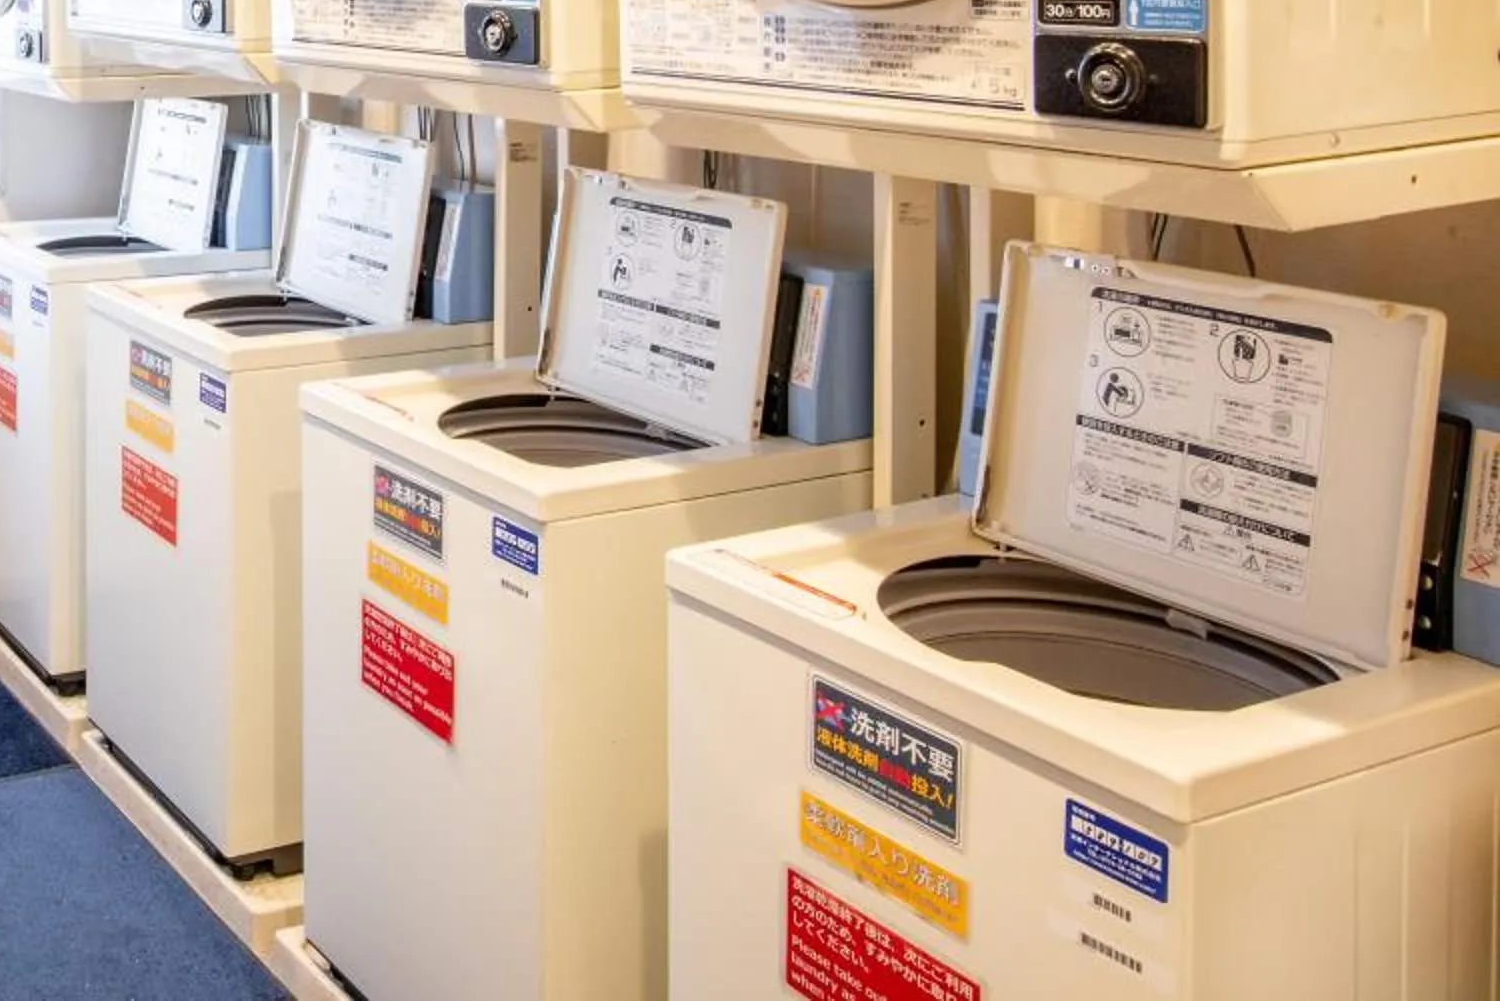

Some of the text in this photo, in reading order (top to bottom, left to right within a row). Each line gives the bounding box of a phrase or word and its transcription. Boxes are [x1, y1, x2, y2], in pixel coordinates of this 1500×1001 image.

[816, 726, 955, 810] 液体洗剤投入!
[850, 707, 954, 783] 洗剤不要
[791, 934, 831, 970] Please
[833, 963, 863, 992] take
[791, 950, 839, 994] laundry
[793, 910, 871, 974] してください。
